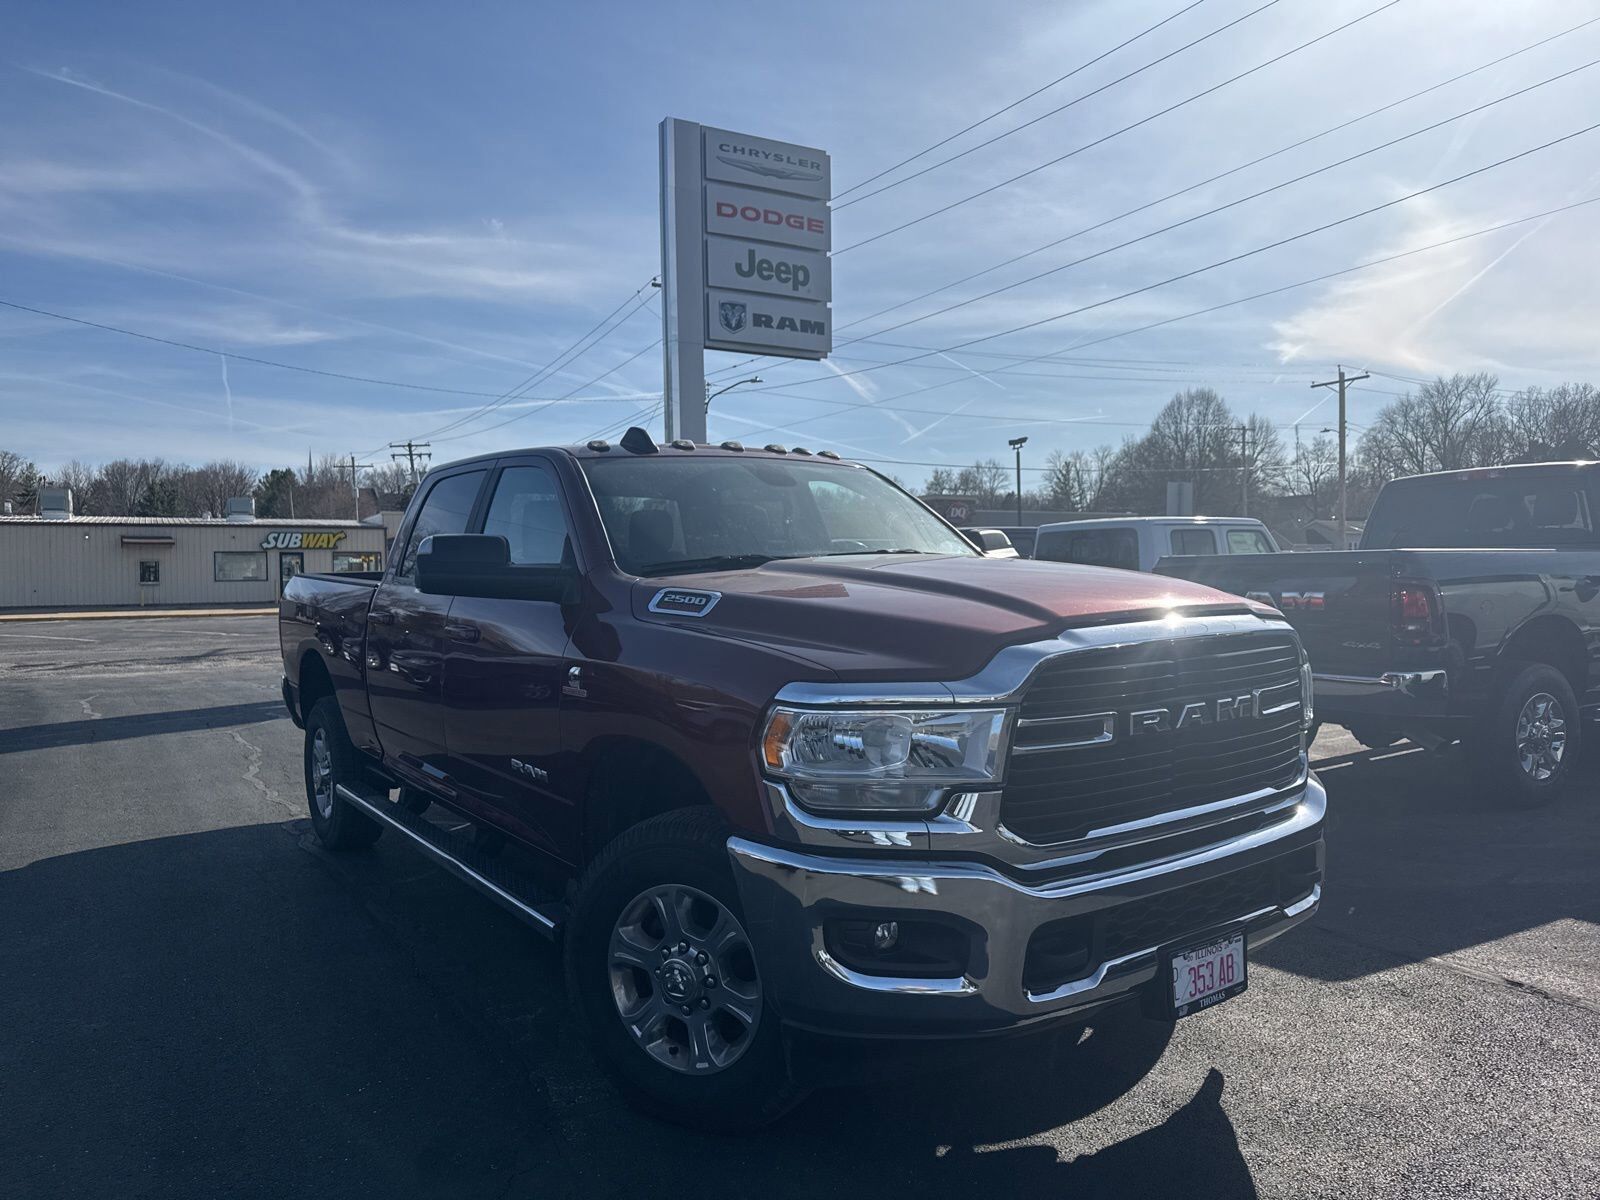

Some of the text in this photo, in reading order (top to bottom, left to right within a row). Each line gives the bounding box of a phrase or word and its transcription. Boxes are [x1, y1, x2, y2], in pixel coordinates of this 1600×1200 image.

[719, 143, 821, 171] CHRYSLER
[716, 201, 825, 234] DODGE
[735, 249, 810, 291] Jeep
[752, 312, 825, 336] RAM
[261, 530, 347, 551] SUBWAY
[664, 594, 707, 606] 2500
[1130, 694, 1252, 736] RAM
[511, 758, 549, 783] RAM
[1195, 944, 1223, 960] ILLINOIS
[1188, 953, 1234, 998] 353 AB
[1200, 991, 1226, 1007] THOMAS
